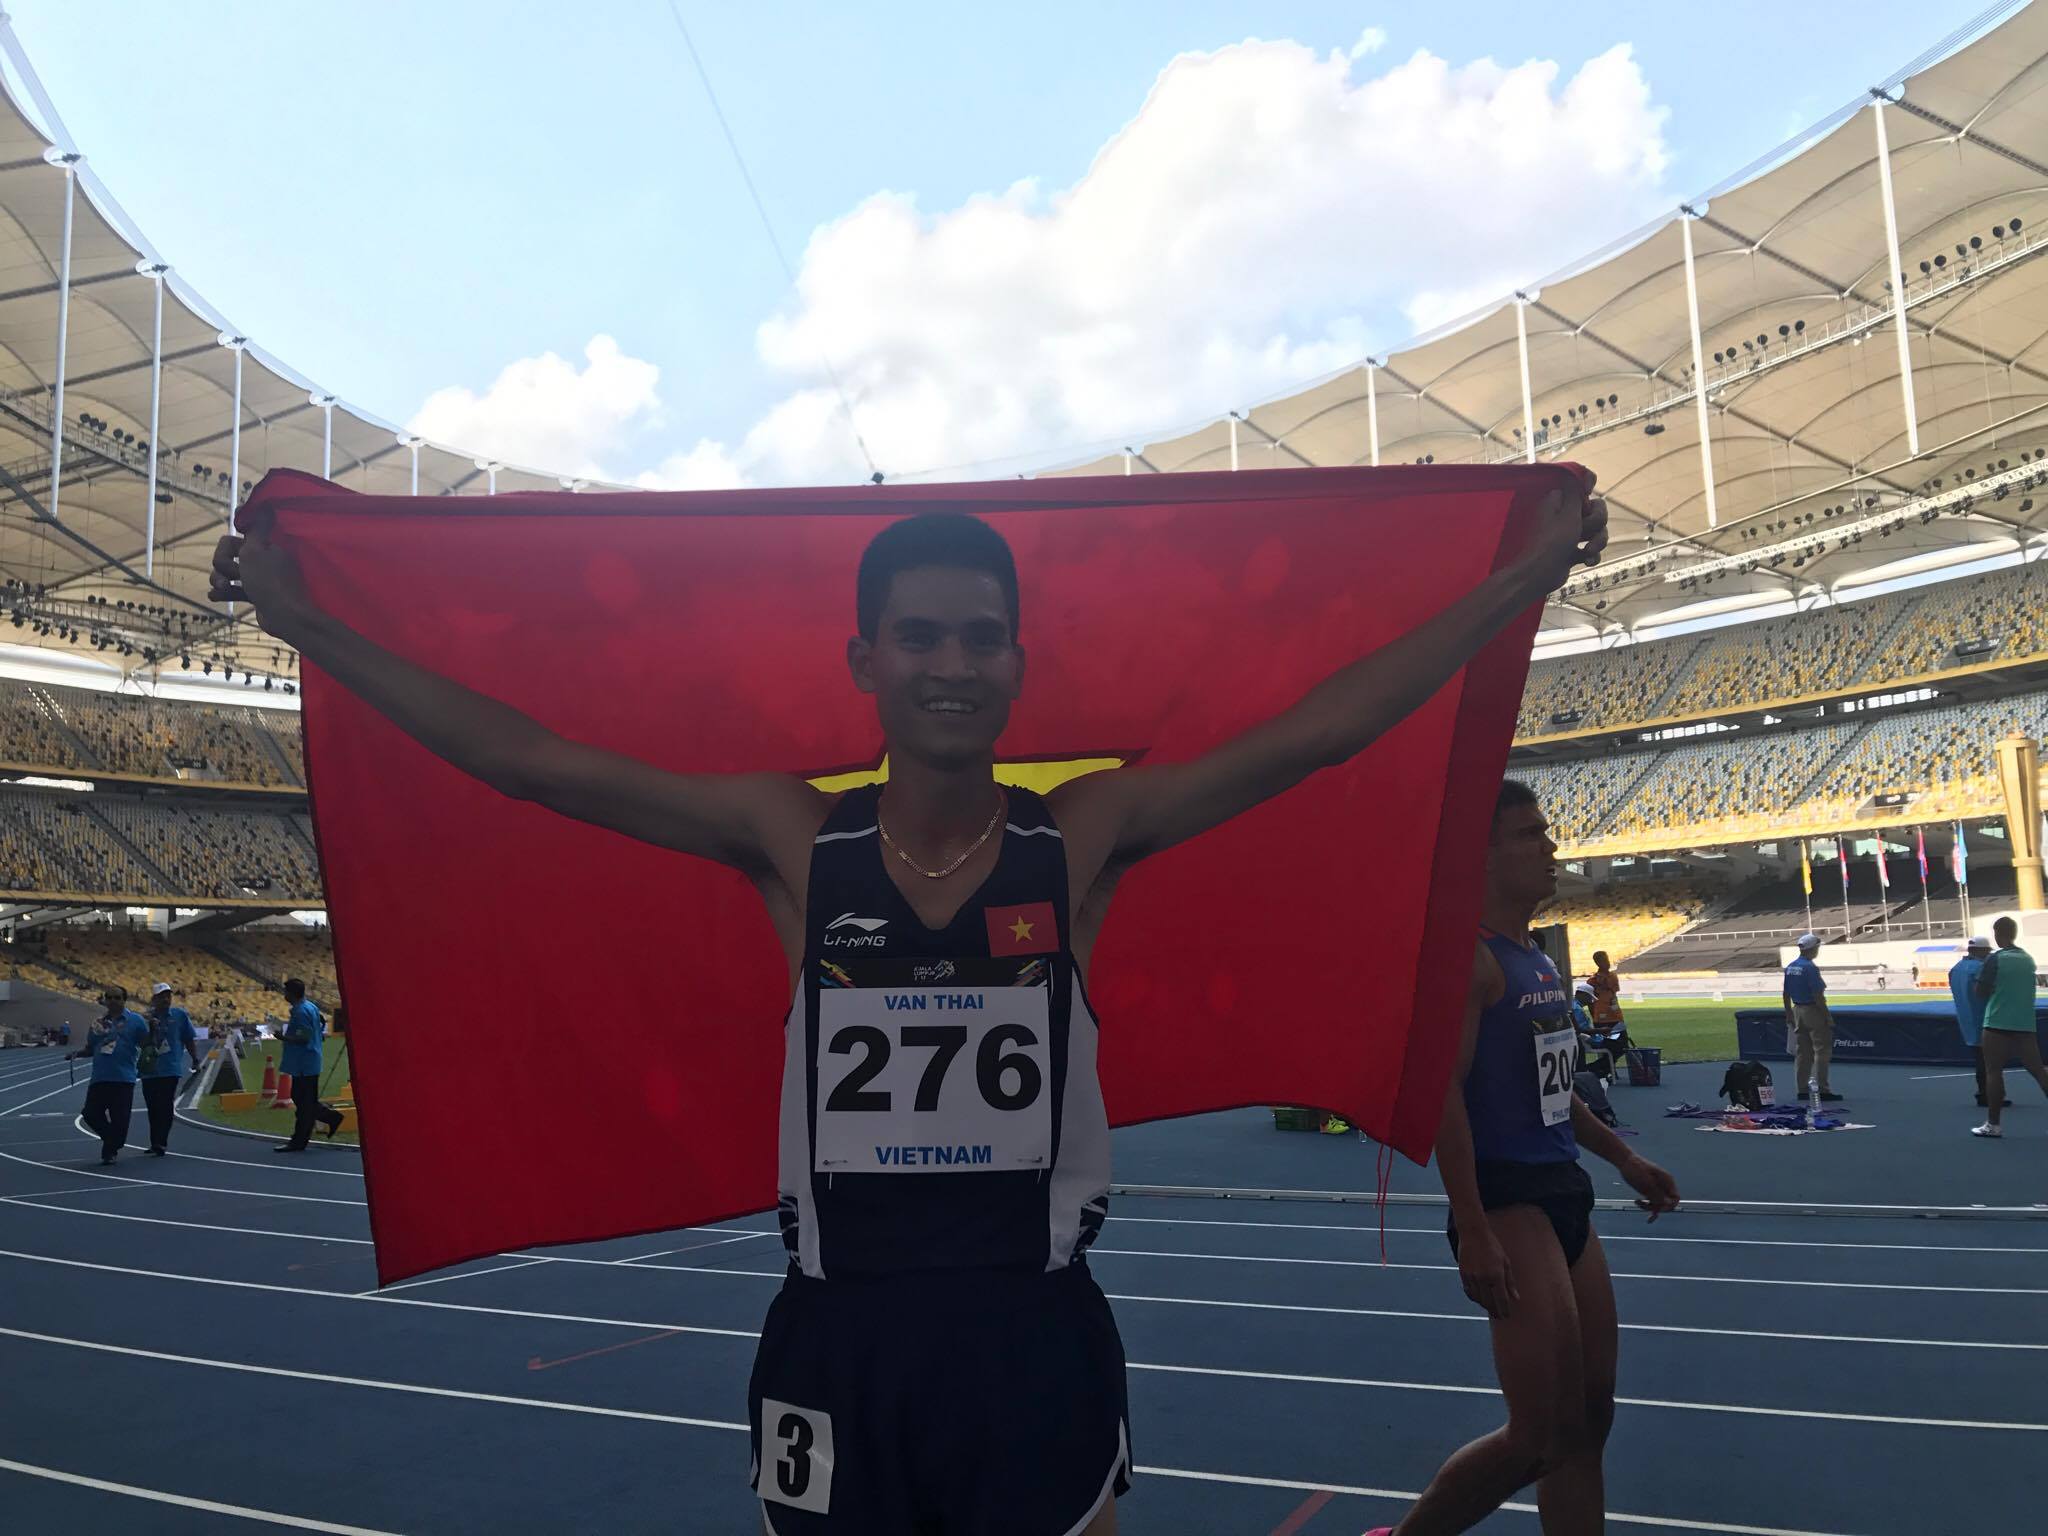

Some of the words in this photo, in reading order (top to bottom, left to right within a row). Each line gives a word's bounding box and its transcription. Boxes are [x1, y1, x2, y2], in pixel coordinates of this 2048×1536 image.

[823, 934, 887, 948] LI-NING
[884, 995, 927, 1010] VAN
[933, 994, 984, 1010] THAI
[825, 1023, 1042, 1112] 276
[875, 1145, 992, 1165] VIETNAM
[777, 1412, 814, 1498] 3
